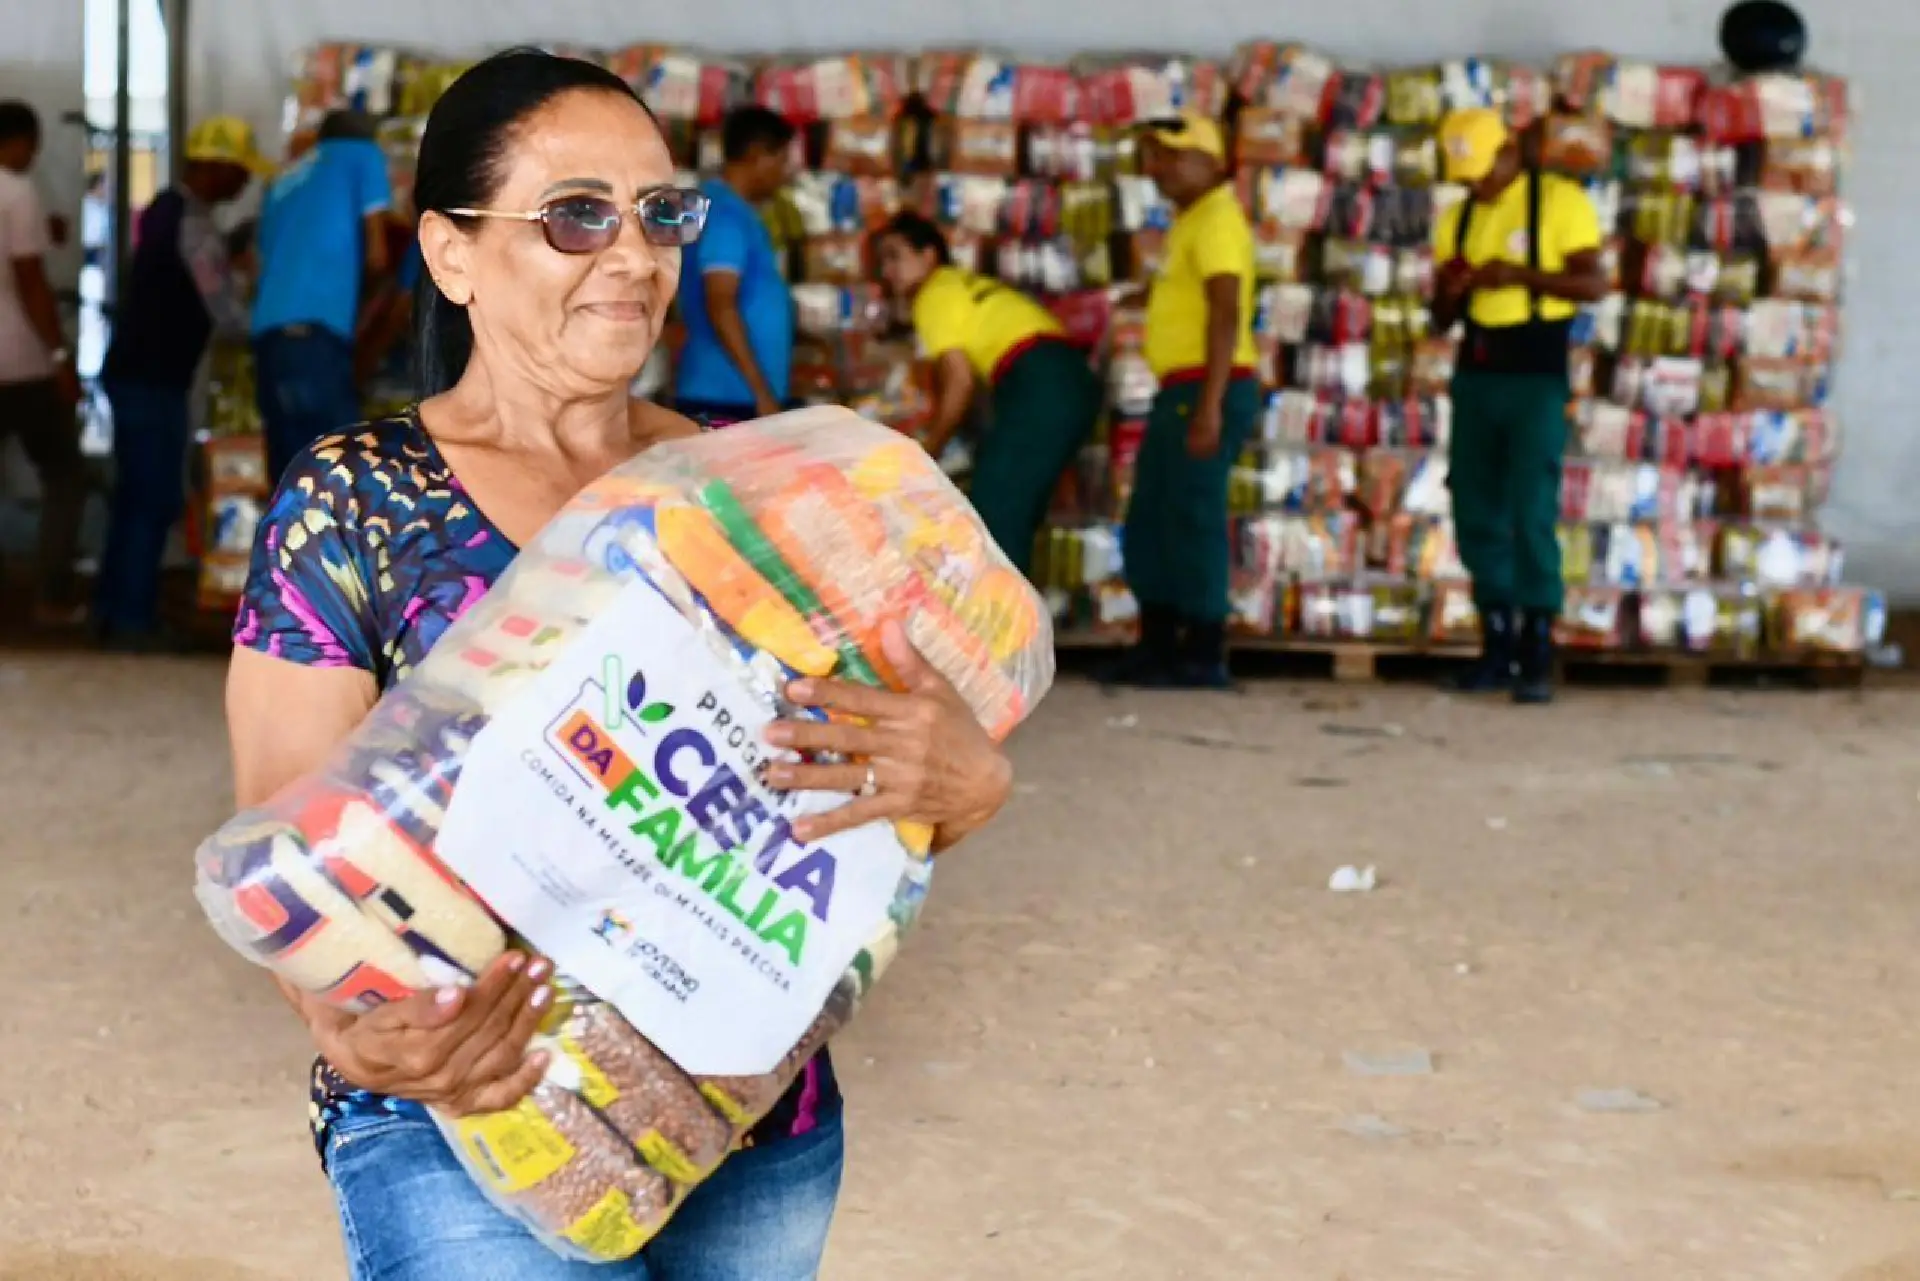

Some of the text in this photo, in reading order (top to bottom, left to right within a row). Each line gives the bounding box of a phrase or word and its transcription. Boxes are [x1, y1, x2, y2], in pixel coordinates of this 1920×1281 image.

[570, 725, 613, 775] DA
[520, 749, 574, 806] COMIDA
[577, 806, 596, 828] NA
[691, 905, 728, 940] MAIS
[731, 936, 791, 993] PRECISA
